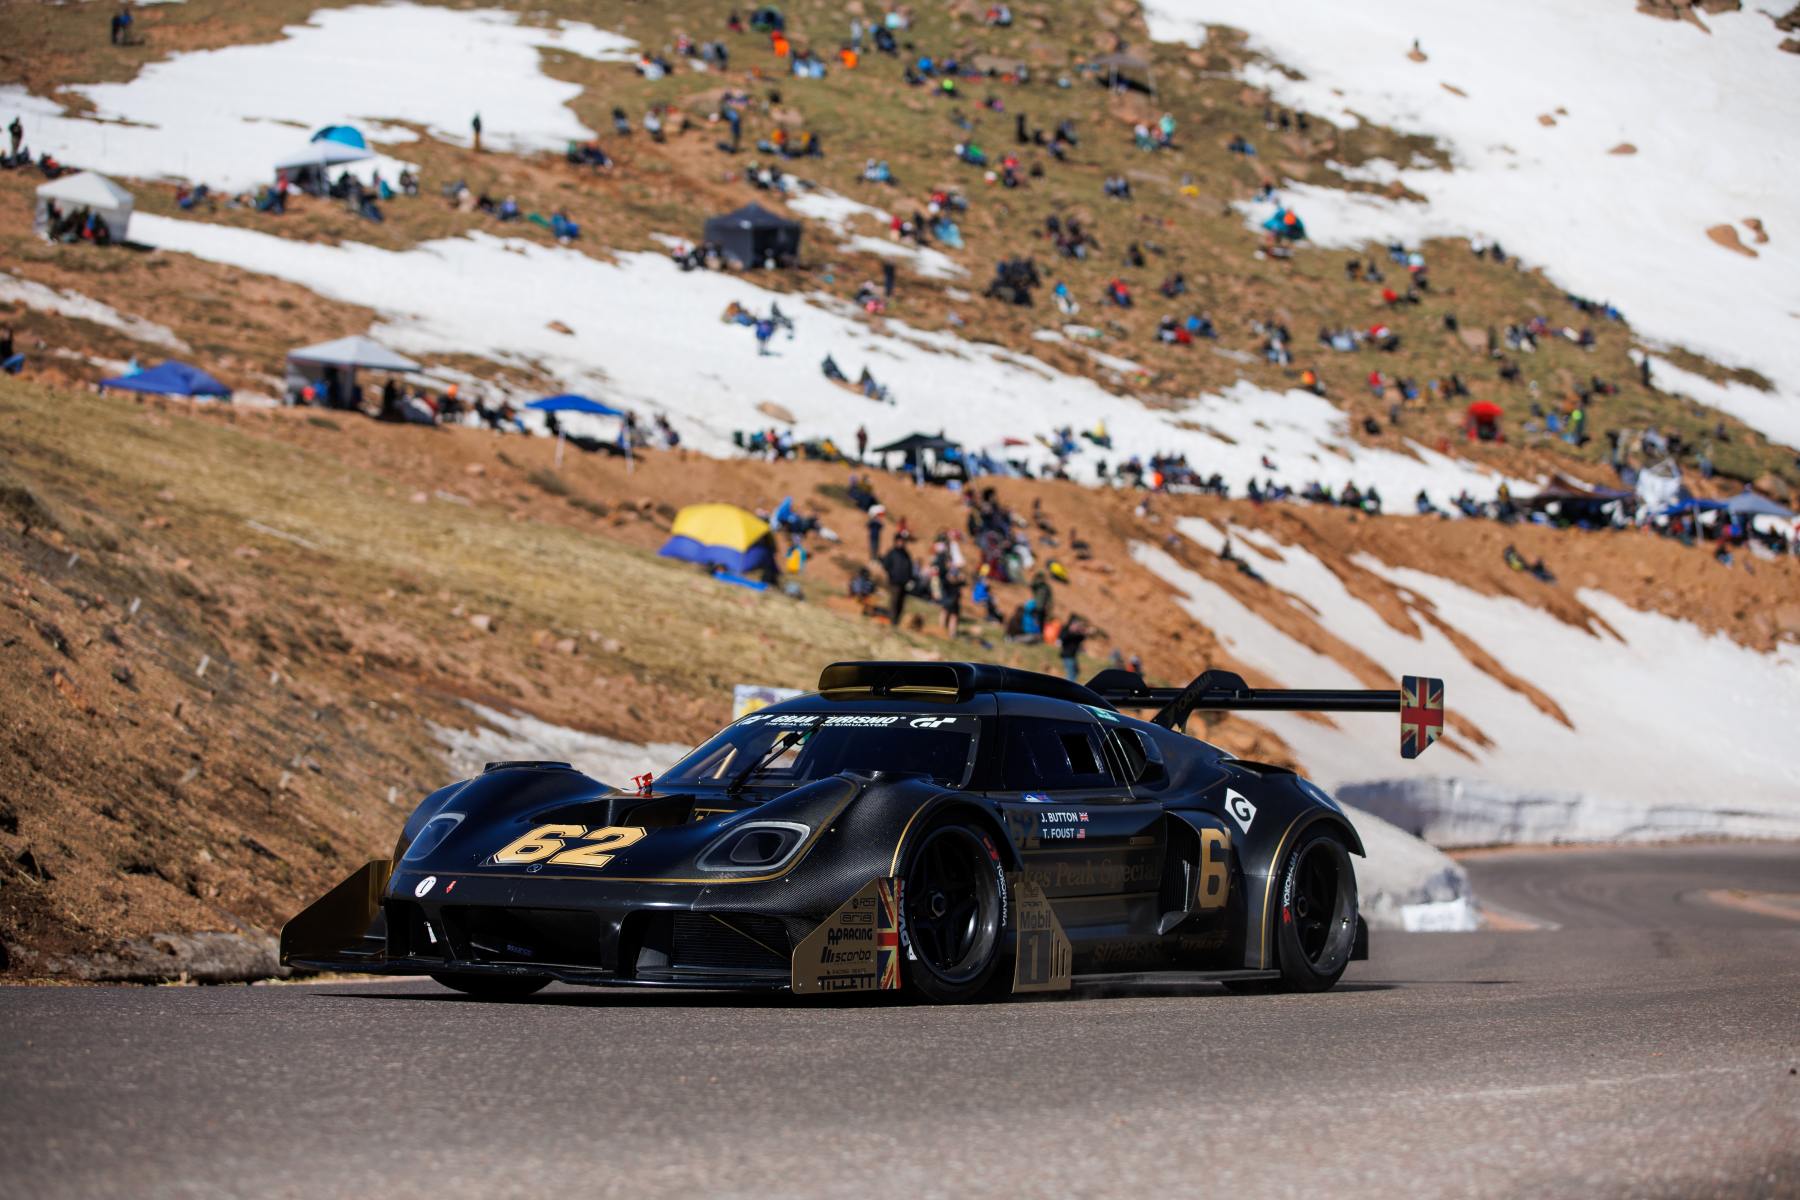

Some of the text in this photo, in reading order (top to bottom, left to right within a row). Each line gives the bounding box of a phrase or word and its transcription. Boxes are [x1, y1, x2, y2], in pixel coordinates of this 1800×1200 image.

[1041, 812, 1079, 823] J. BUTTON
[1043, 828, 1074, 838] T. FOUST
[494, 823, 648, 868] 62
[996, 861, 1008, 928] YOKOHAMA
[1020, 911, 1051, 928] Mobil
[843, 928, 873, 941] RACING
[817, 973, 876, 991] TILLETT
